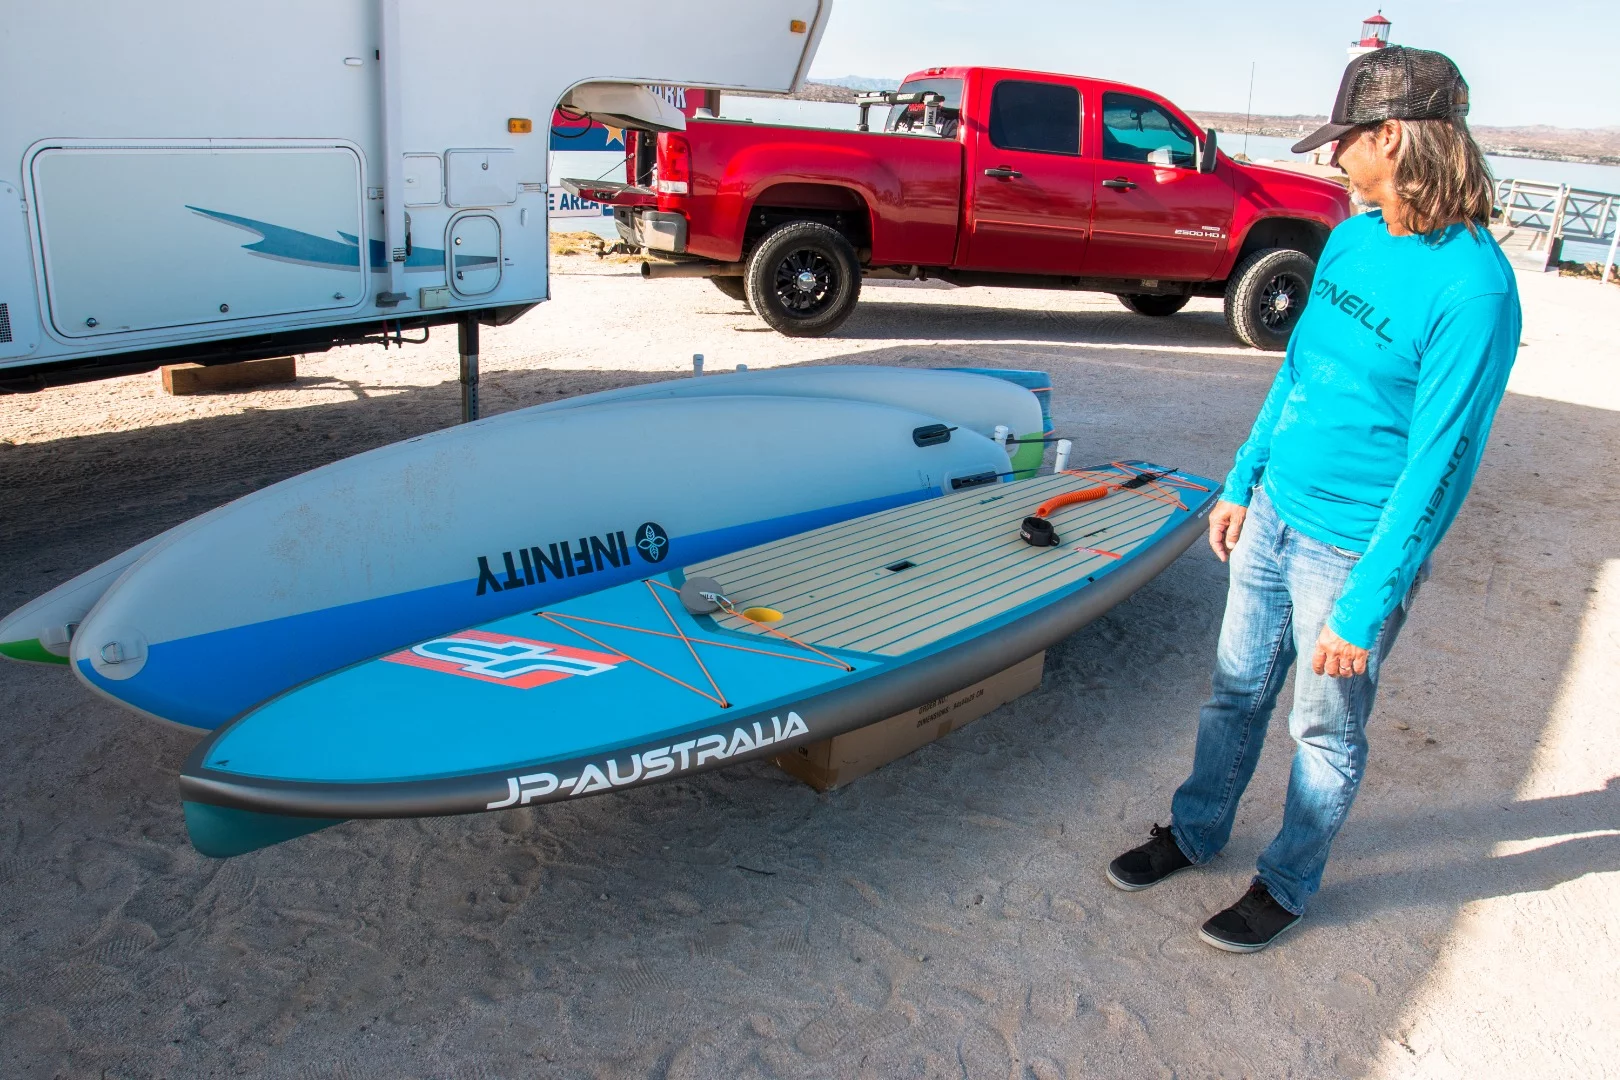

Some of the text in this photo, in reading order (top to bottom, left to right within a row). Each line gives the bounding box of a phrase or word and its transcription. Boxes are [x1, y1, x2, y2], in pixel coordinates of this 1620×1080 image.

[1315, 279, 1393, 343] O'NEILL
[1402, 435, 1469, 550] O'NEILL
[476, 531, 631, 596] INFINITY
[486, 711, 809, 810] JP-AUSTRALIA
